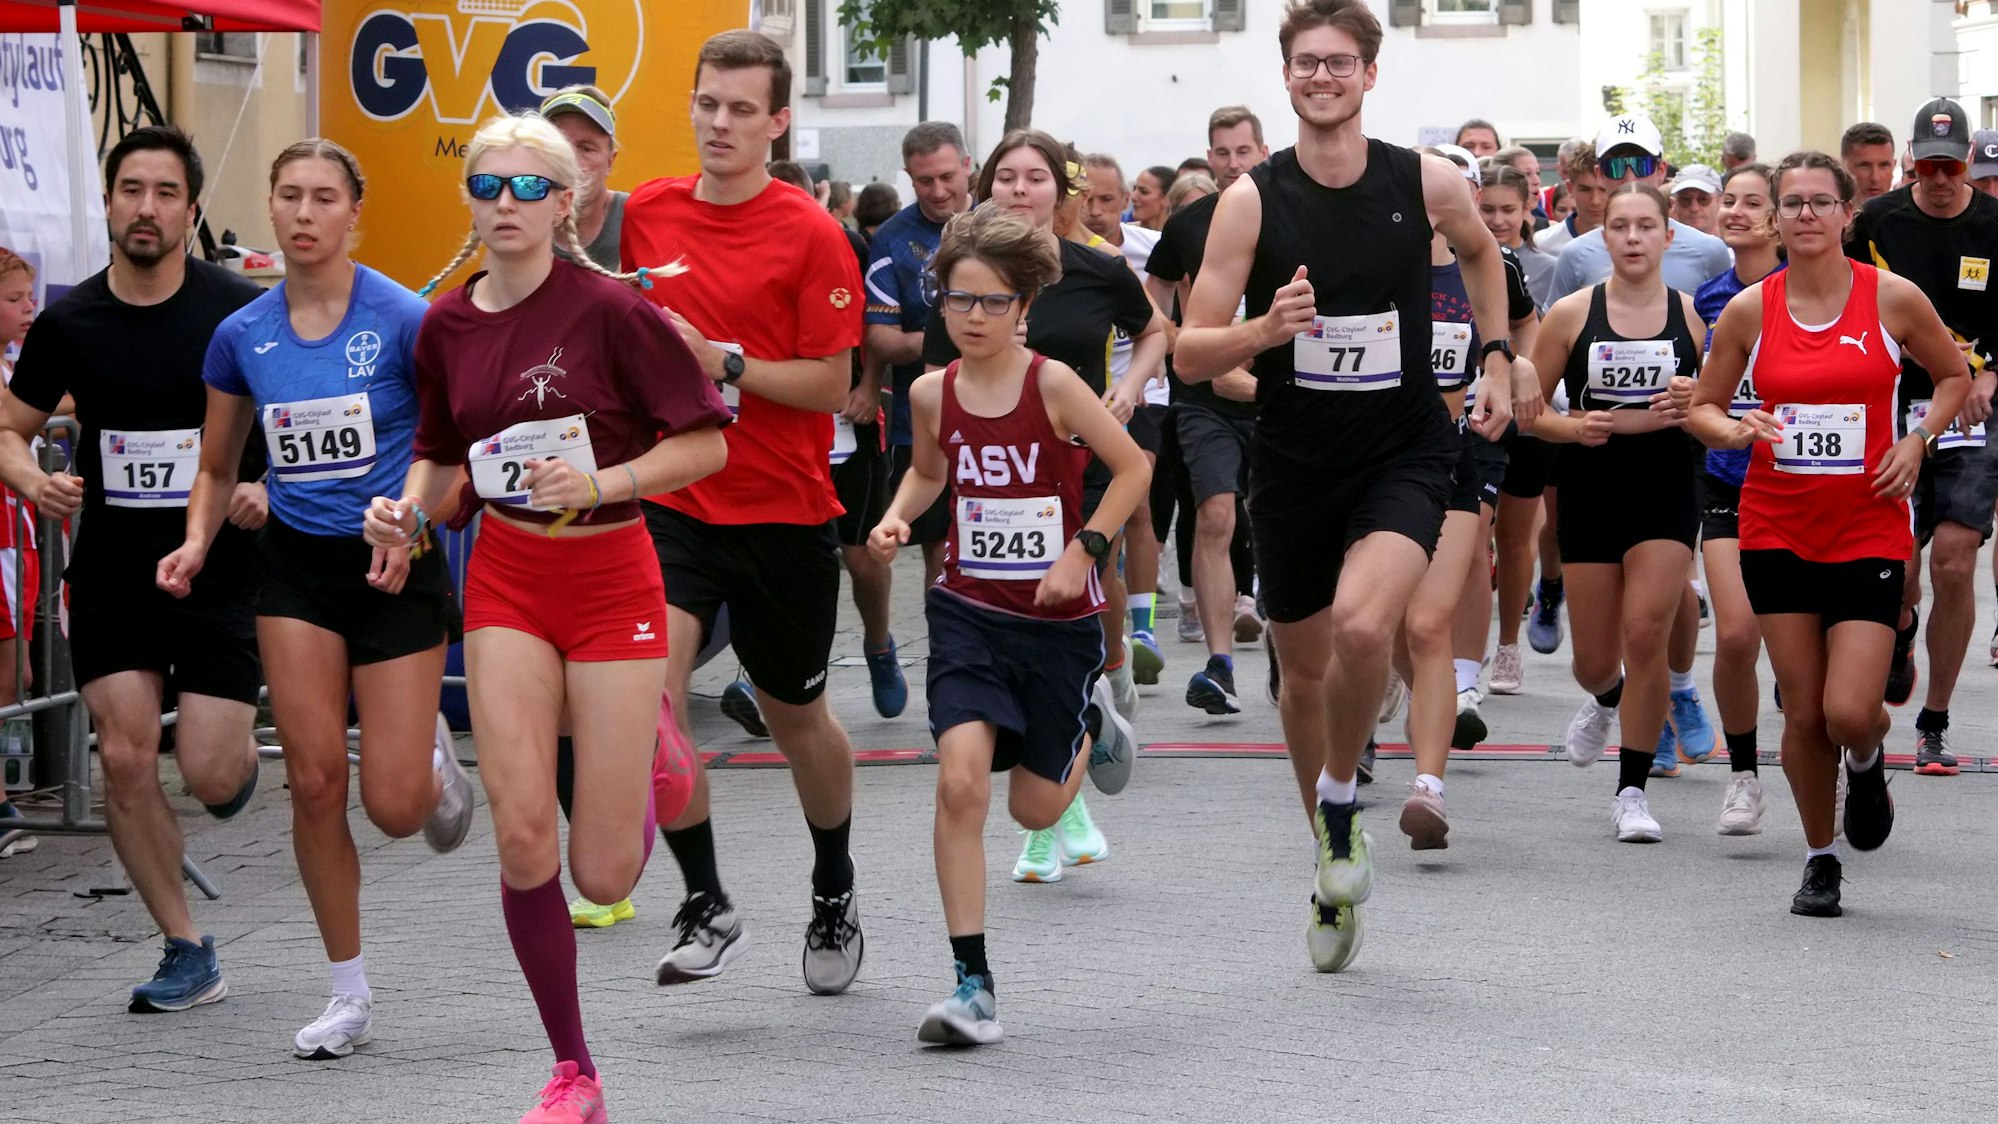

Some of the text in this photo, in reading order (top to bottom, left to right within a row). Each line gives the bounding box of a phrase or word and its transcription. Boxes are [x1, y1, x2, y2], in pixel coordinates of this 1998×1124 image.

[350, 9, 597, 124] GVG
[1617, 119, 1635, 134] NY
[435, 136, 468, 158] Me
[1326, 326, 1367, 334] GVG-Citylauf
[1329, 346, 1366, 372] 77
[1431, 348, 1457, 370] 46
[348, 365, 376, 378] LAV
[1602, 366, 1661, 388] 5247
[278, 427, 362, 464] 5149
[504, 443, 535, 452] Bedburg
[1793, 431, 1842, 457] 138
[123, 462, 176, 489] 157
[956, 441, 1040, 487] ASV
[971, 530, 1047, 559] 5243
